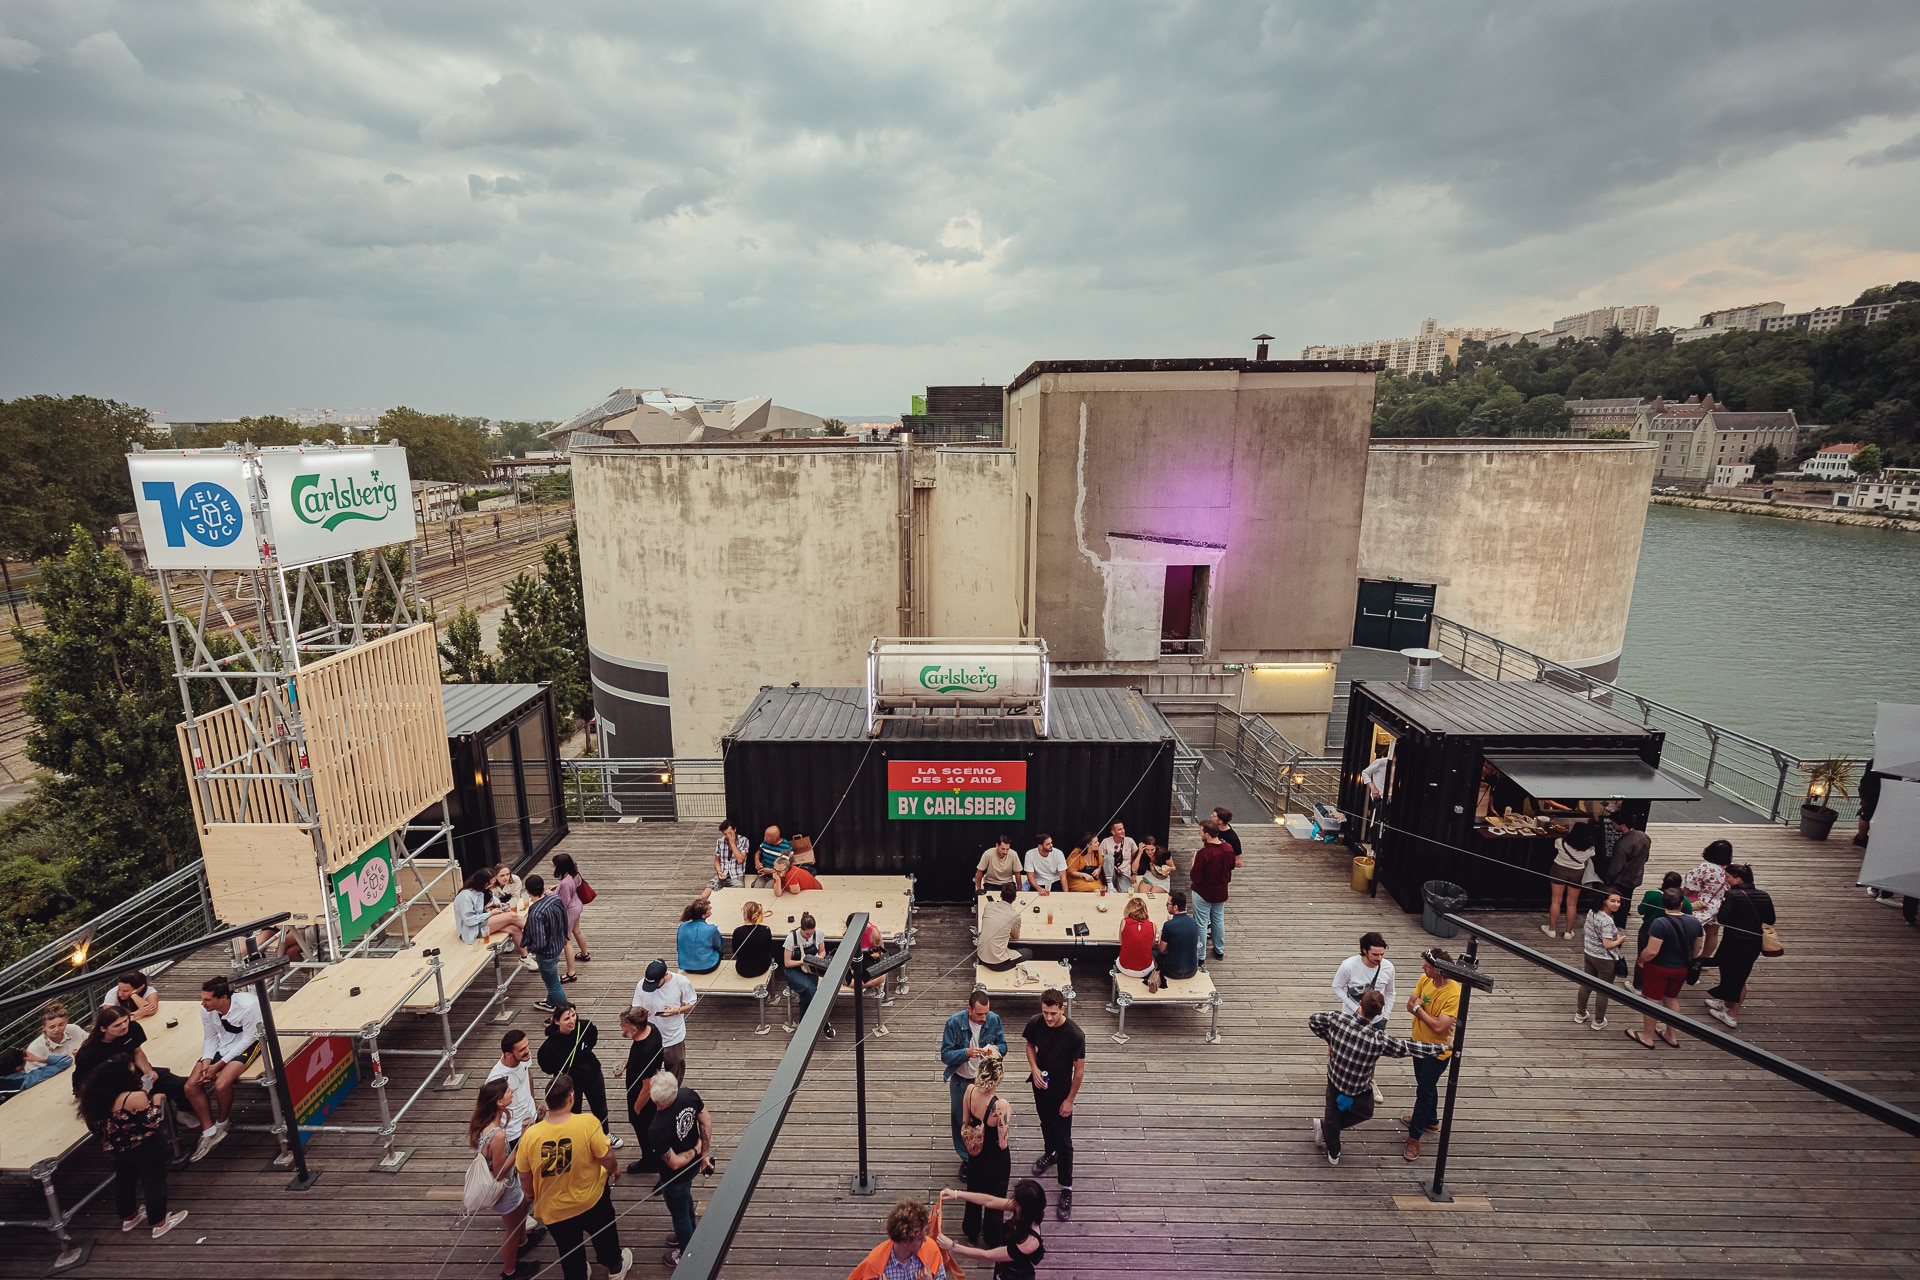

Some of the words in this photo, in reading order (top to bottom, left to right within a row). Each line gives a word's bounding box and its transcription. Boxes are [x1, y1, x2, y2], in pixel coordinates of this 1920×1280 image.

[290, 473, 397, 532] Carlsberg
[919, 665, 998, 694] Carlsberg
[911, 776, 942, 784] DES
[946, 776, 965, 784] 10
[969, 776, 1002, 784] ANS
[917, 767, 937, 775] LA
[898, 796, 919, 815] BY
[923, 796, 1016, 816] CARLSBERG
[305, 1038, 334, 1083] 4
[295, 1056, 351, 1114] NGREDIENTS
[299, 1096, 325, 1125] C'EST
[326, 1072, 349, 1096] TOUT
[541, 1138, 572, 1177] 20
